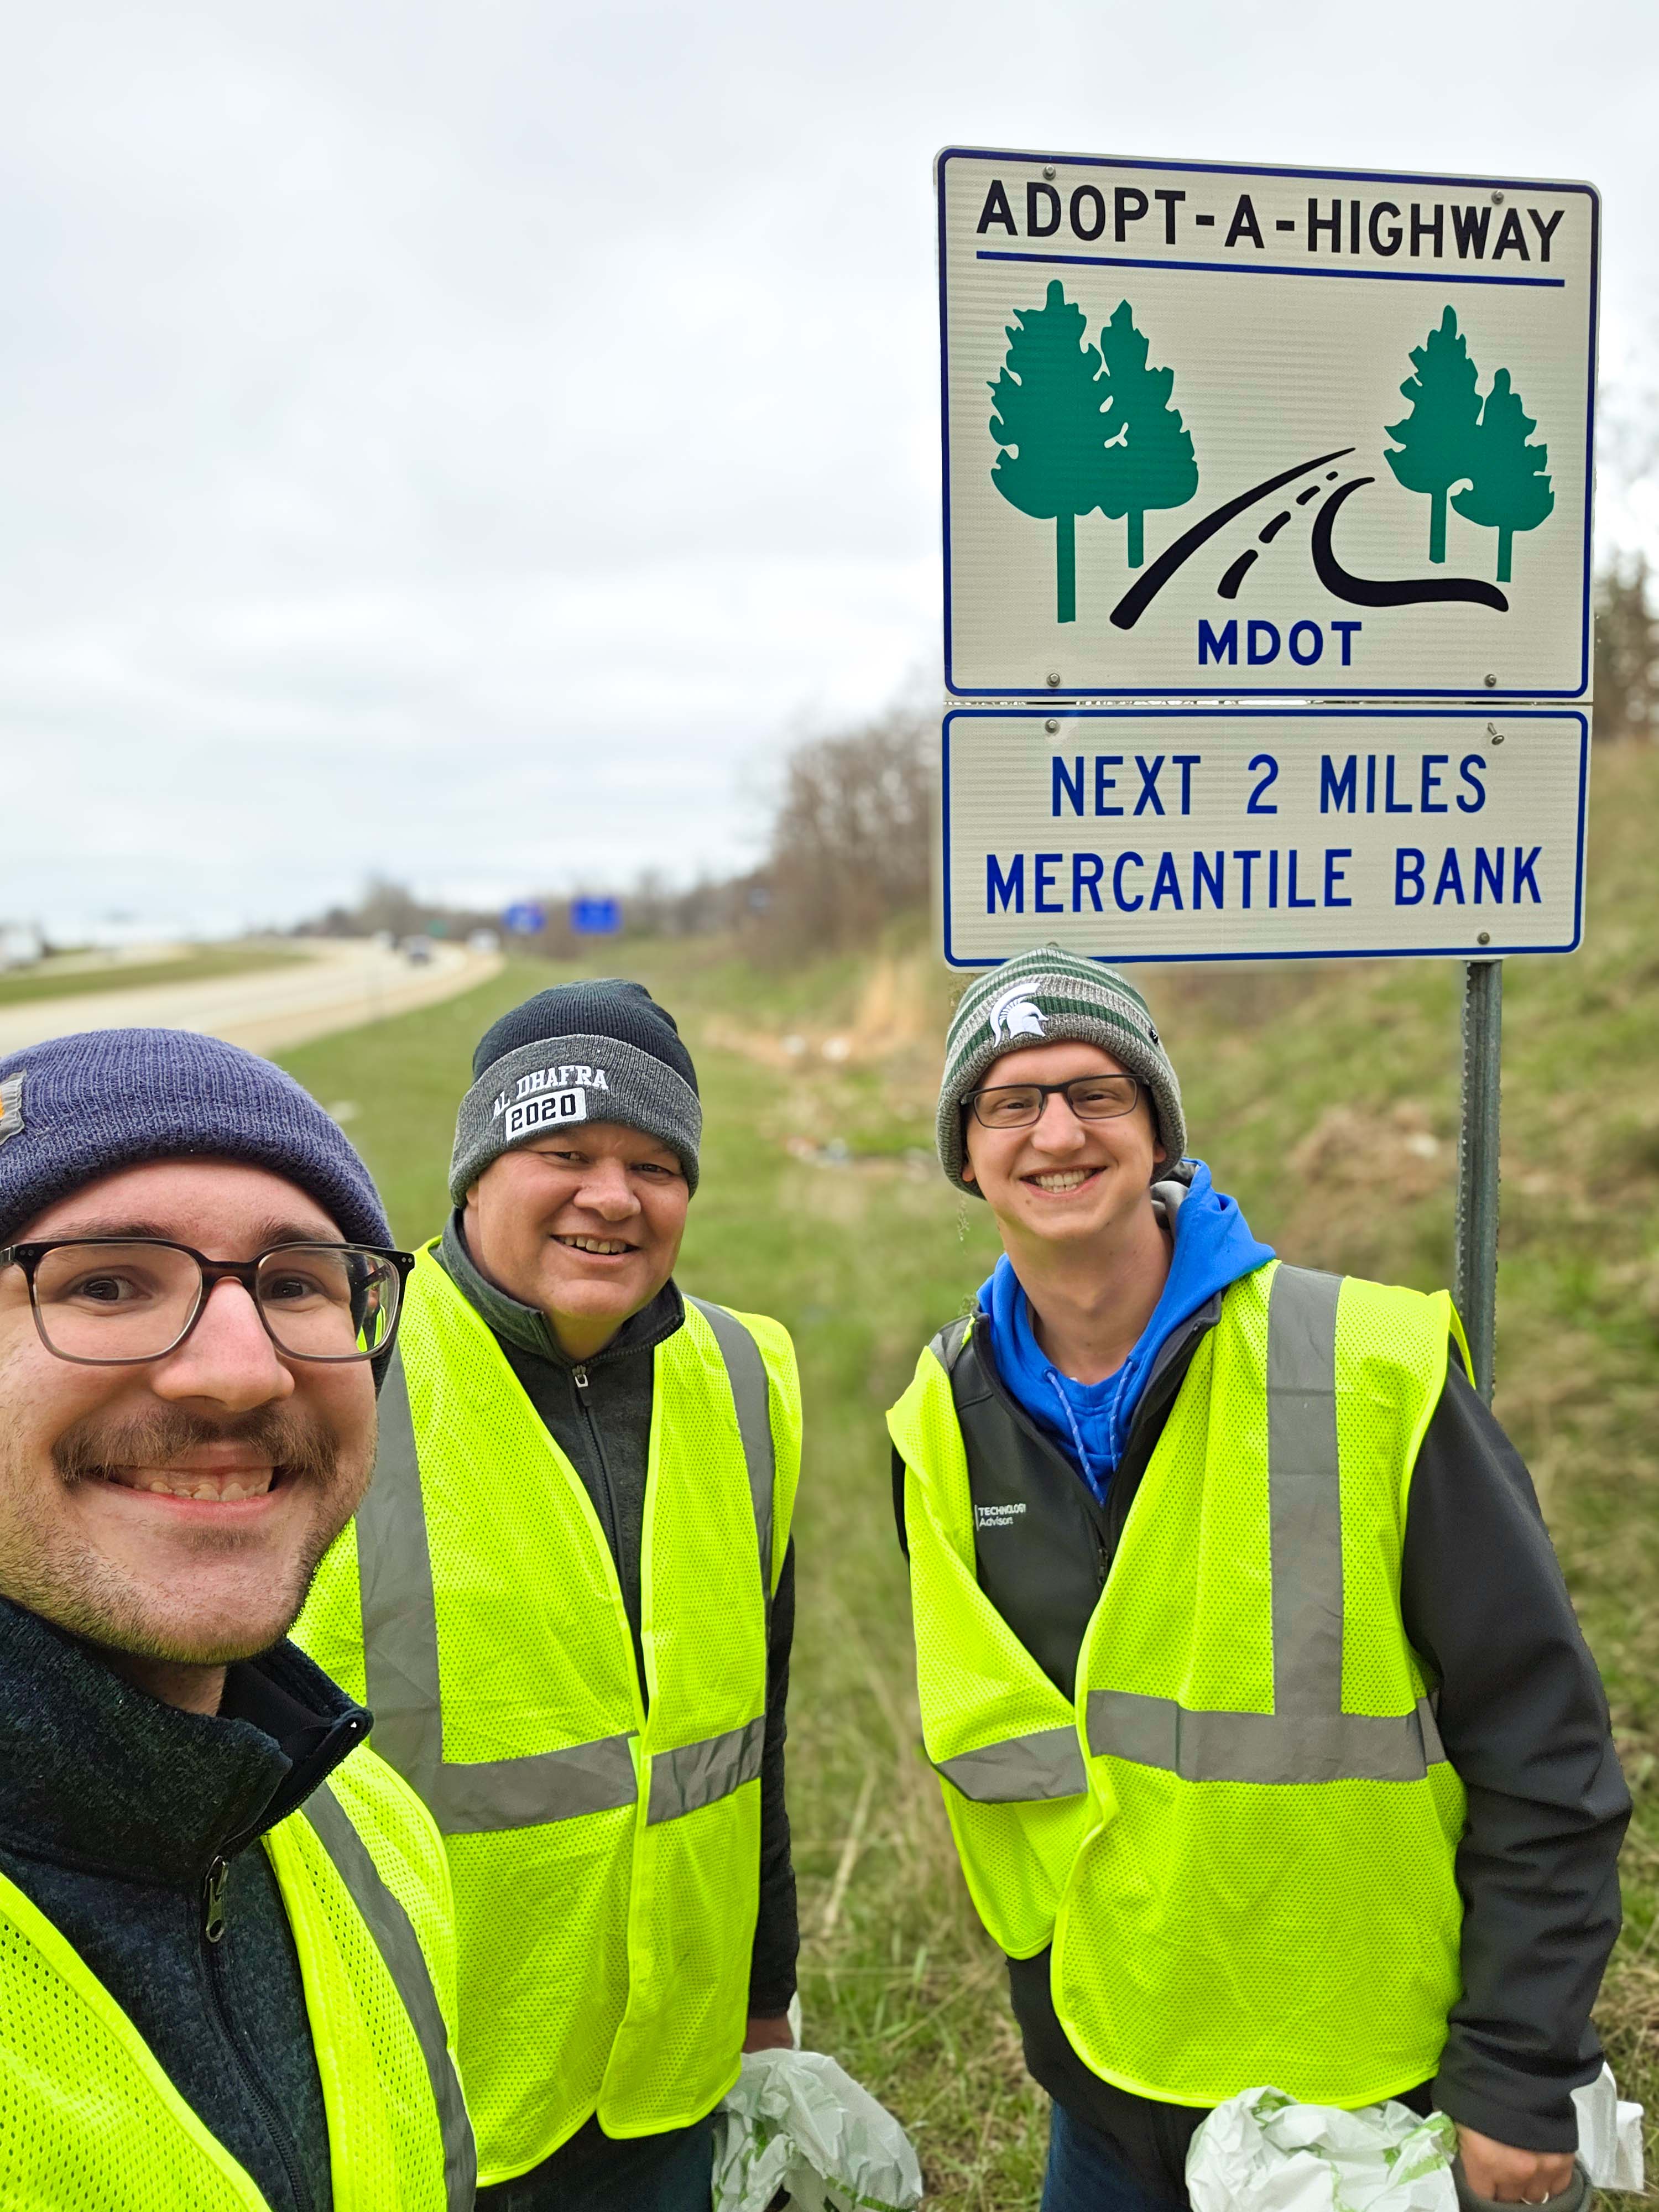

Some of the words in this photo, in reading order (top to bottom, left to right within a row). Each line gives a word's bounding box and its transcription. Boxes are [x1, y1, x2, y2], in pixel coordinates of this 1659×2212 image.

[976, 179, 1566, 263] ADOPT-A-HIGHWAY
[1198, 619, 1362, 666] MDOT
[1052, 755, 1201, 817] NEXT
[1246, 754, 1279, 815] 2
[1319, 753, 1488, 813] MILES
[986, 848, 1353, 914] MERCANTILE
[1395, 846, 1542, 905] BANK
[516, 1065, 609, 1099] DHAFRA
[511, 1093, 576, 1133] 2020
